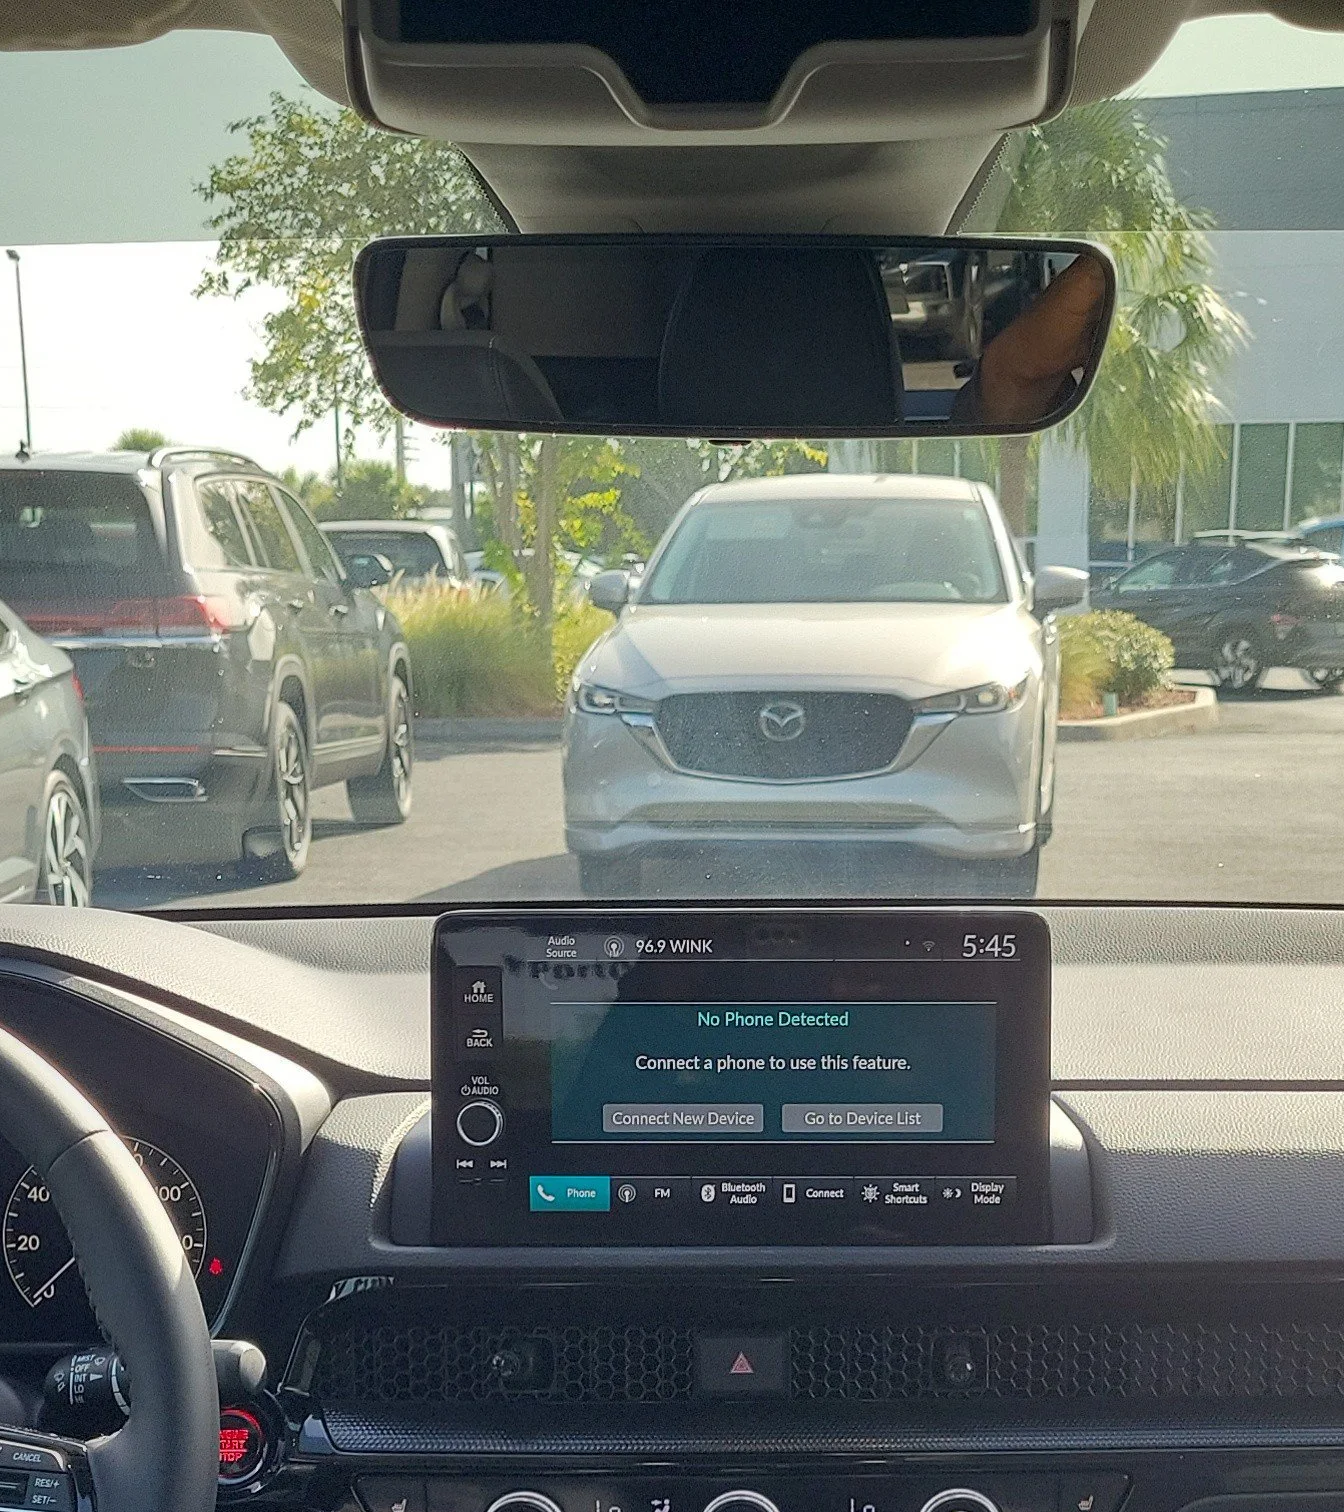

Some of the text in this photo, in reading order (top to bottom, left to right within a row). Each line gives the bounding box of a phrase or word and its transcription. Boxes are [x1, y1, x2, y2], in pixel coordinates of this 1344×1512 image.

[547, 936, 576, 946] Audio
[962, 934, 1017, 958] 5:45
[635, 940, 713, 953] 96.9 WINK
[546, 948, 577, 958] Source
[464, 993, 494, 1003] HOME
[697, 1012, 849, 1027] No Phone Detected
[466, 1038, 493, 1048] BACK
[635, 1055, 911, 1073] Connect a phone to use this feature.
[471, 1076, 490, 1085] VOL
[472, 1086, 499, 1095] AUDIO
[612, 1112, 755, 1126] Connect New Device
[805, 1112, 921, 1125] Go to Device List
[721, 1183, 766, 1193] Bluetooth
[892, 1183, 920, 1192] Smart
[971, 1183, 1004, 1194] Display
[28, 1187, 50, 1202] 40
[567, 1188, 596, 1198] Phone
[654, 1189, 671, 1198] FM
[806, 1189, 844, 1198] Connect
[729, 1195, 758, 1204] Audio
[884, 1195, 928, 1204] Shortcuts
[974, 1195, 1001, 1204] Mode
[17, 1235, 40, 1251] 20
[75, 1363, 90, 1373] OFF
[74, 1374, 87, 1382] INT
[74, 1384, 84, 1394] LO
[13, 1452, 41, 1463] CANCEL
